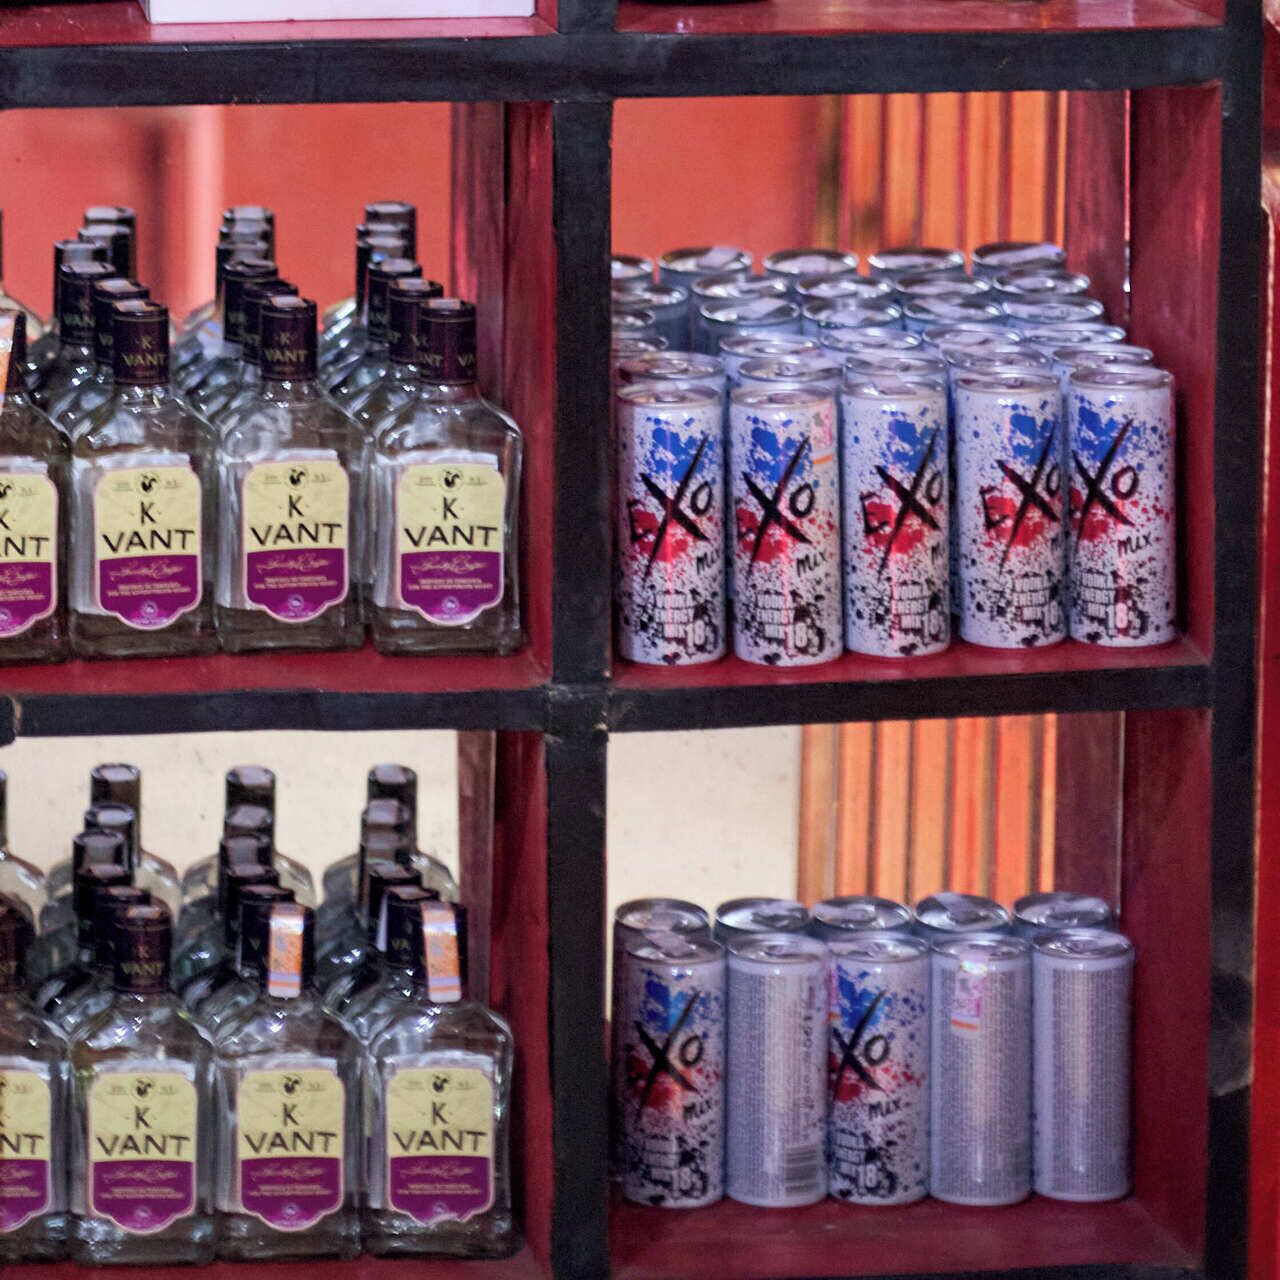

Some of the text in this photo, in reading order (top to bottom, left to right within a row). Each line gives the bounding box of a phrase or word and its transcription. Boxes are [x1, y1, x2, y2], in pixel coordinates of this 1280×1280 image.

[122, 352, 167, 367] VANT
[264, 349, 308, 363] VANT
[140, 501, 157, 525] K
[288, 494, 305, 518] K
[442, 496, 458, 520] K
[102, 529, 195, 554] VANT
[250, 522, 342, 546] VANT
[404, 525, 498, 548] VANT
[134, 1105, 152, 1129] K
[283, 1101, 300, 1127] K
[431, 1101, 449, 1125] K
[97, 1134, 191, 1158] VANT
[244, 1130, 337, 1154] VANT
[393, 1130, 487, 1152] VANT
